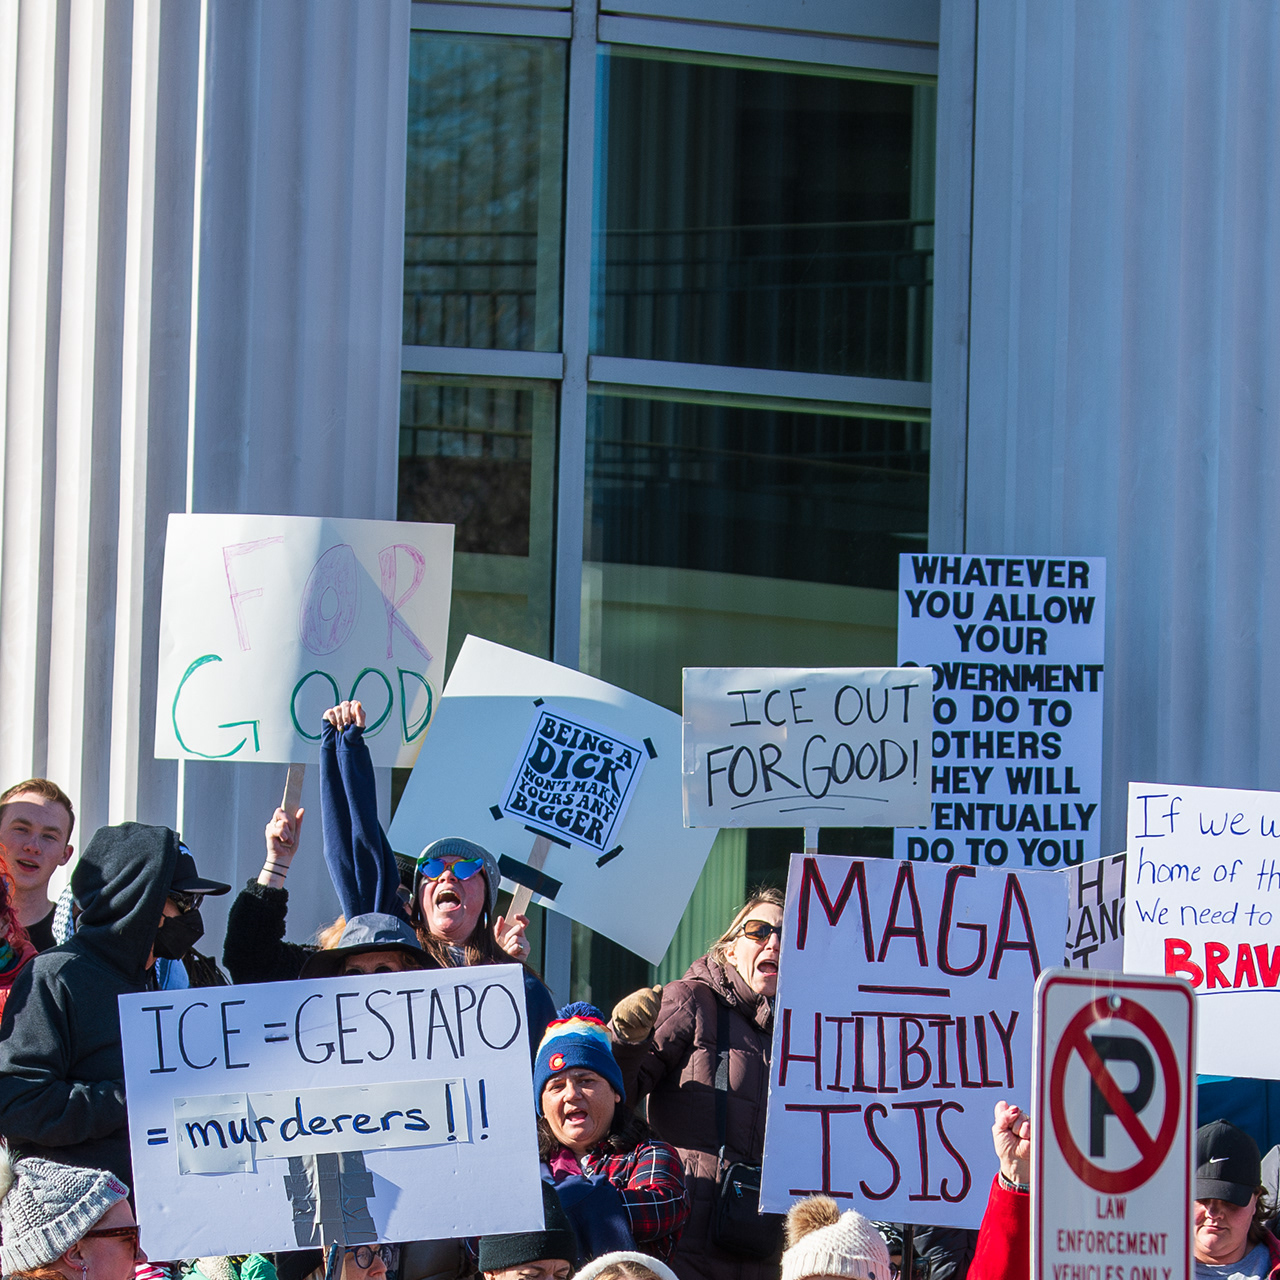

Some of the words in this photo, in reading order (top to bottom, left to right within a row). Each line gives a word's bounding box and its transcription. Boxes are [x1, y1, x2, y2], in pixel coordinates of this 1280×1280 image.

[911, 556, 1090, 589] WHATEVER
[222, 536, 433, 662] FOR
[905, 591, 974, 622] YOU
[983, 594, 1096, 624] ALLOW
[955, 624, 1047, 656] YOUR
[171, 653, 437, 758] GOOD
[726, 686, 814, 727] ICE
[833, 683, 920, 726] OUT
[972, 694, 1020, 723] DO
[1028, 698, 1073, 728] TO
[539, 717, 614, 755] BEING
[616, 748, 633, 769] A
[931, 730, 1062, 760] OTHERS
[528, 737, 626, 798] DICK
[706, 745, 801, 807] FOR
[802, 734, 920, 800] GOOD!
[931, 765, 994, 795] HEY
[1005, 766, 1081, 795] WILL
[519, 776, 576, 807] YOURS
[576, 794, 615, 823] ANY
[572, 780, 620, 811] MAKE
[1135, 793, 1182, 839] If
[1198, 811, 1251, 837] we
[510, 791, 605, 846] BIGGER
[907, 836, 955, 864] DO
[965, 838, 1009, 867] TO
[1017, 838, 1085, 867] YOU
[1137, 846, 1201, 886] home
[1213, 858, 1243, 884] of
[796, 855, 1041, 980] MAGA
[1135, 899, 1170, 926] We
[1179, 901, 1236, 927] need
[1244, 903, 1273, 928] to
[141, 999, 250, 1074] ICE
[778, 1008, 1020, 1094] HILLBILLY
[785, 1099, 972, 1203] ISIS
[1096, 1197, 1127, 1220] LAW
[1057, 1228, 1169, 1256] ENFORCEMENT
